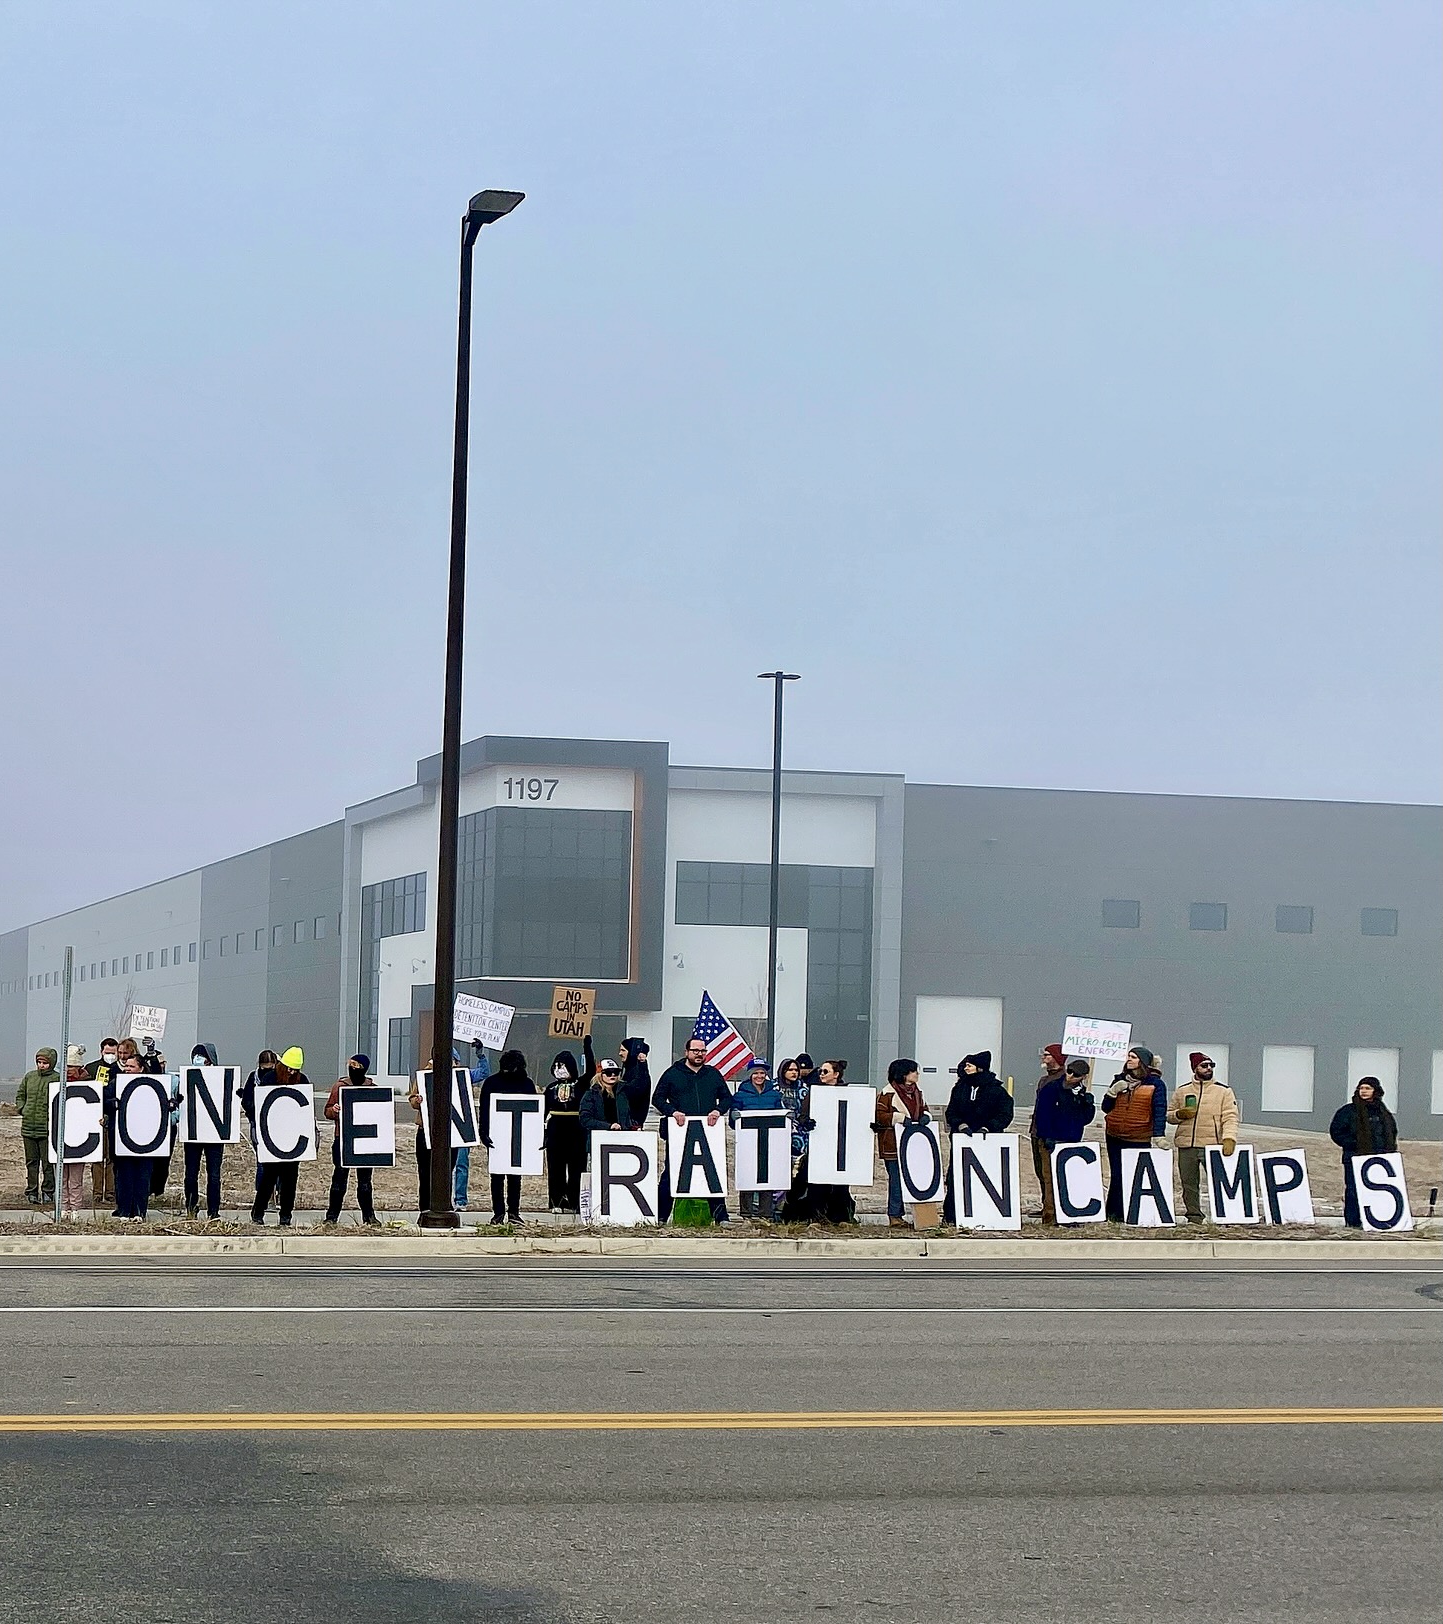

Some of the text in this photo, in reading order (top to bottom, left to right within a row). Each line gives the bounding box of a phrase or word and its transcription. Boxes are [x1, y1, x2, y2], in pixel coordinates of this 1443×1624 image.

[502, 778, 560, 800] 1197
[566, 990, 582, 1002] NO
[556, 1000, 589, 1014] CAMPS
[566, 1012, 576, 1022] IN
[554, 1018, 585, 1037] UTAH
[1075, 1019, 1100, 1029] ICE
[1064, 1036, 1127, 1050] MICRO PENIS
[1078, 1046, 1118, 1056] ENERGY
